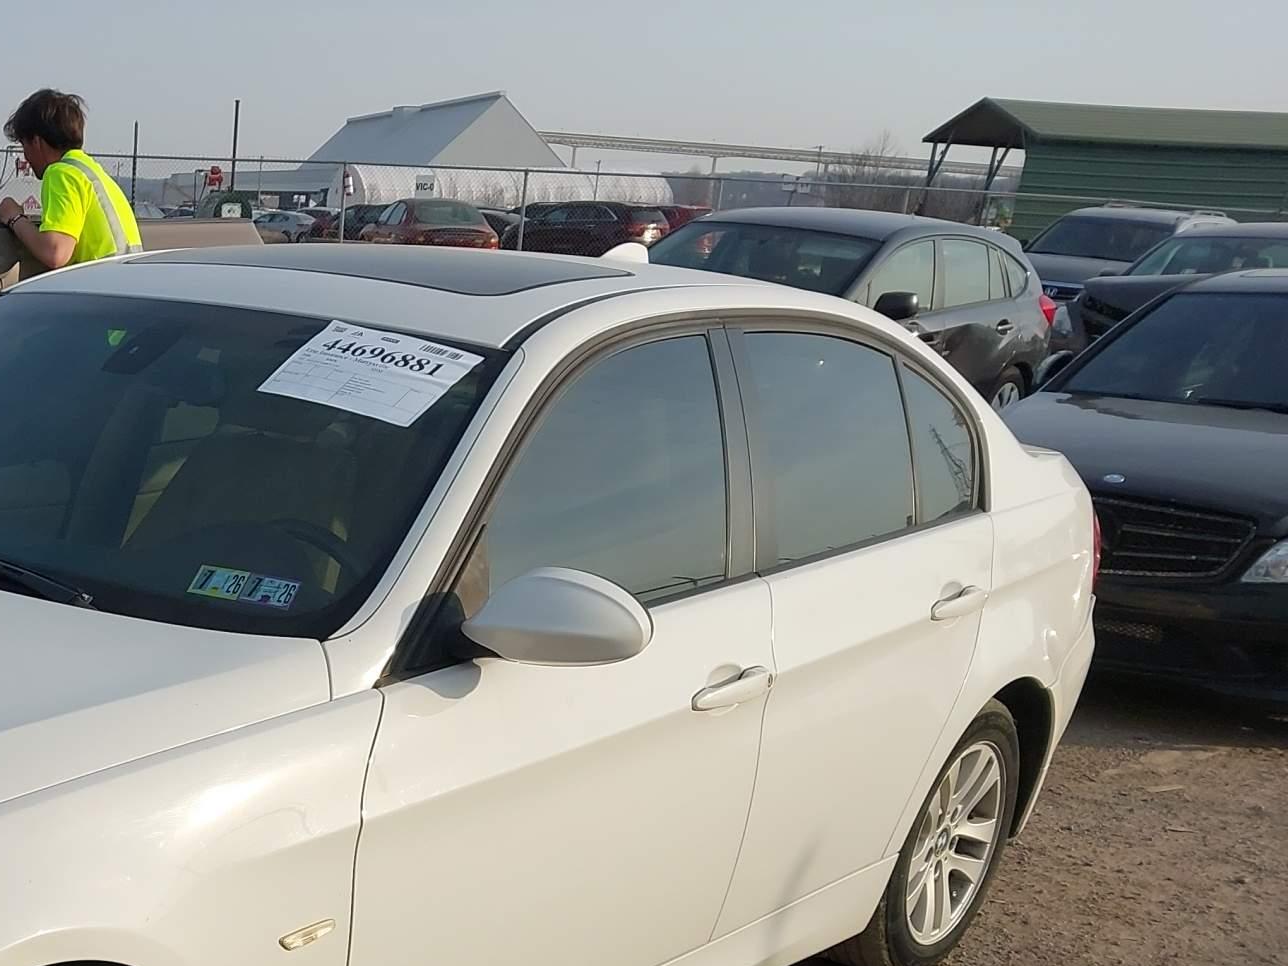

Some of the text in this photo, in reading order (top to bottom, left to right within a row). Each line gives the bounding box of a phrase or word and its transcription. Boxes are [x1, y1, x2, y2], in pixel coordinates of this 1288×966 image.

[322, 338, 445, 378] 44696881
[225, 574, 245, 594] 26
[247, 577, 297, 604] 7 26
